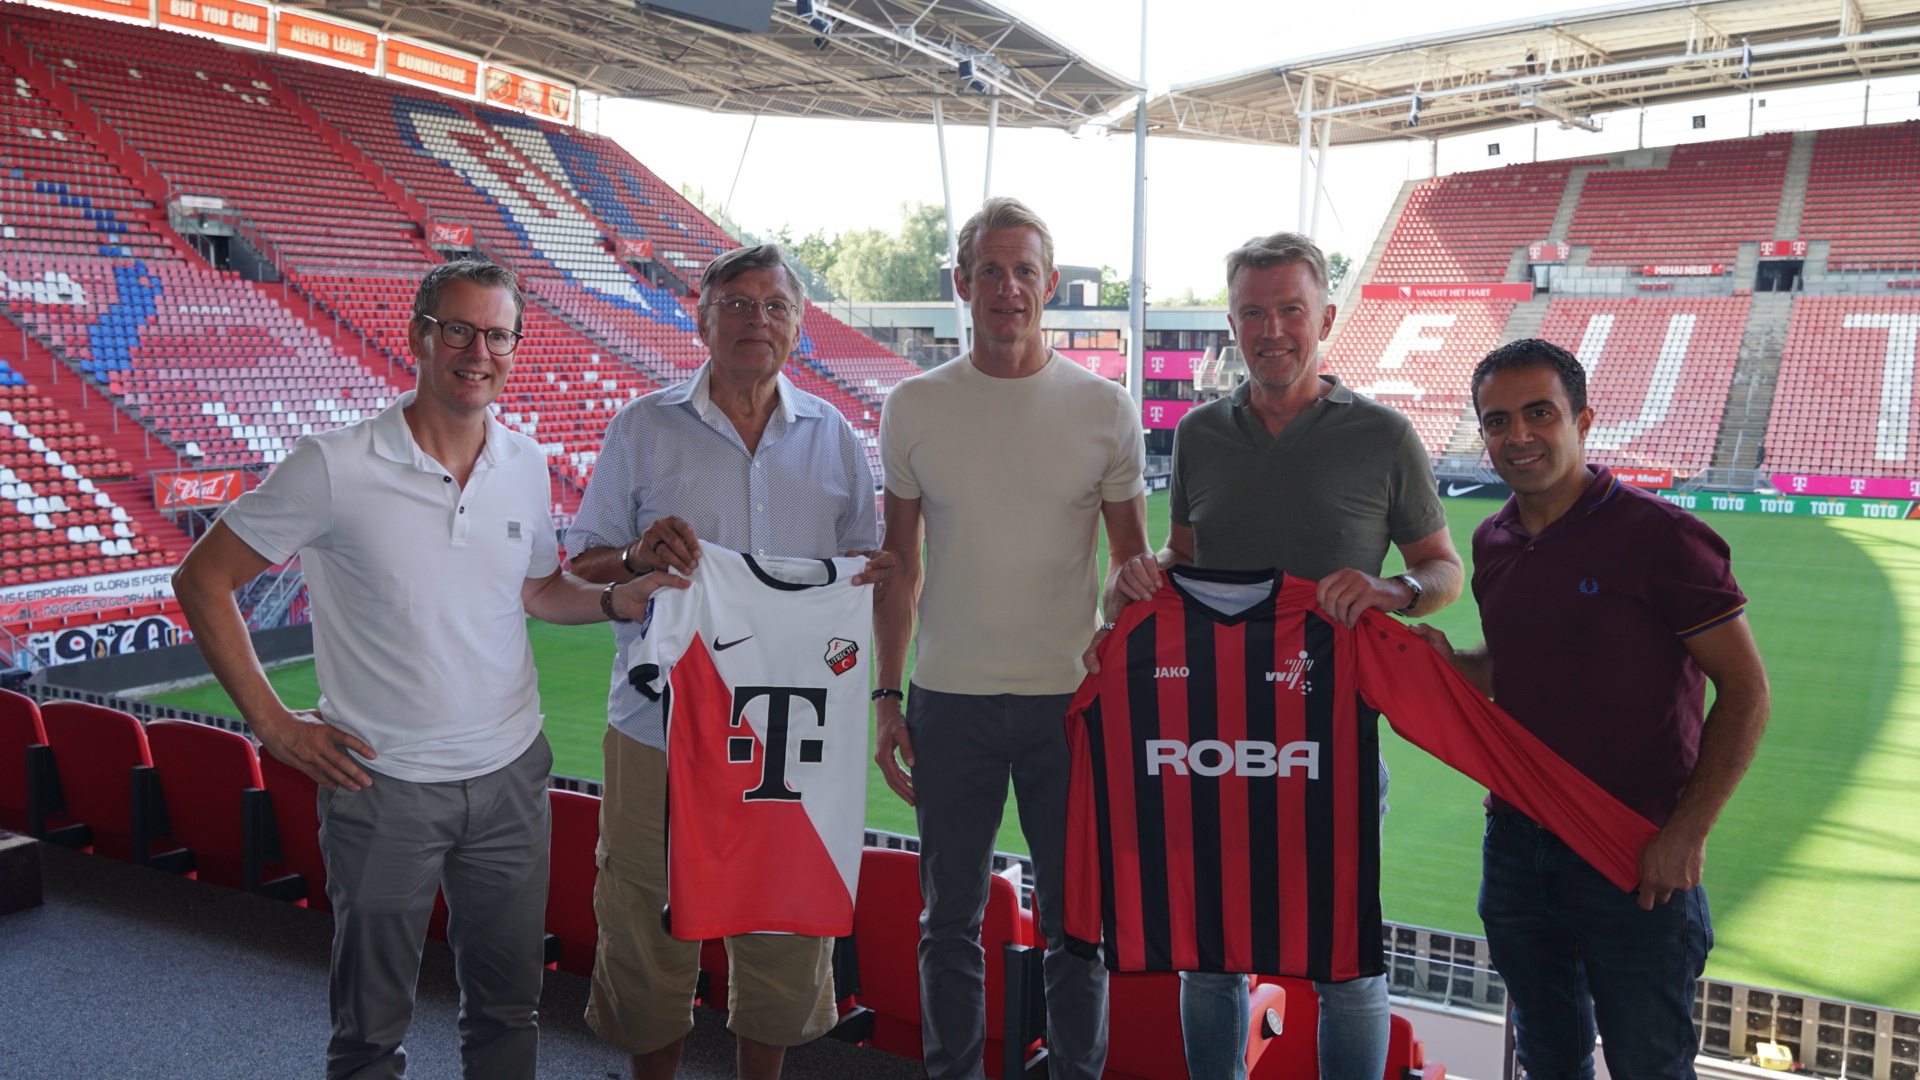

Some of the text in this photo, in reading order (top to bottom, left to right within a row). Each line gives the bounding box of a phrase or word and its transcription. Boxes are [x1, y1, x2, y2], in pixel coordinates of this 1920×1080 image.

[170, 0, 259, 33] BUT YOU CAN
[291, 25, 367, 58] NEVER LEAVE
[397, 51, 467, 84] BUNNIKSIDE
[1654, 265, 1712, 275] MIHAI NESU
[1415, 288, 1491, 297] VANUIT HET HART
[1151, 357, 1164, 373] T
[1150, 406, 1163, 422] T
[177, 478, 217, 499] Bud
[1793, 476, 1807, 492] T
[1850, 479, 1866, 495] T
[1711, 496, 1744, 511] TOTO
[1760, 499, 1794, 513] TOTO
[1810, 501, 1845, 516] TOTO
[1861, 503, 1898, 518] TOTO
[18, 584, 88, 602] TEMPORARY
[94, 577, 130, 592] GLORY
[828, 643, 858, 666] UTRECHT
[1153, 666, 1190, 678] JAKO
[728, 686, 828, 802] T
[1145, 739, 1320, 780] ROBA
